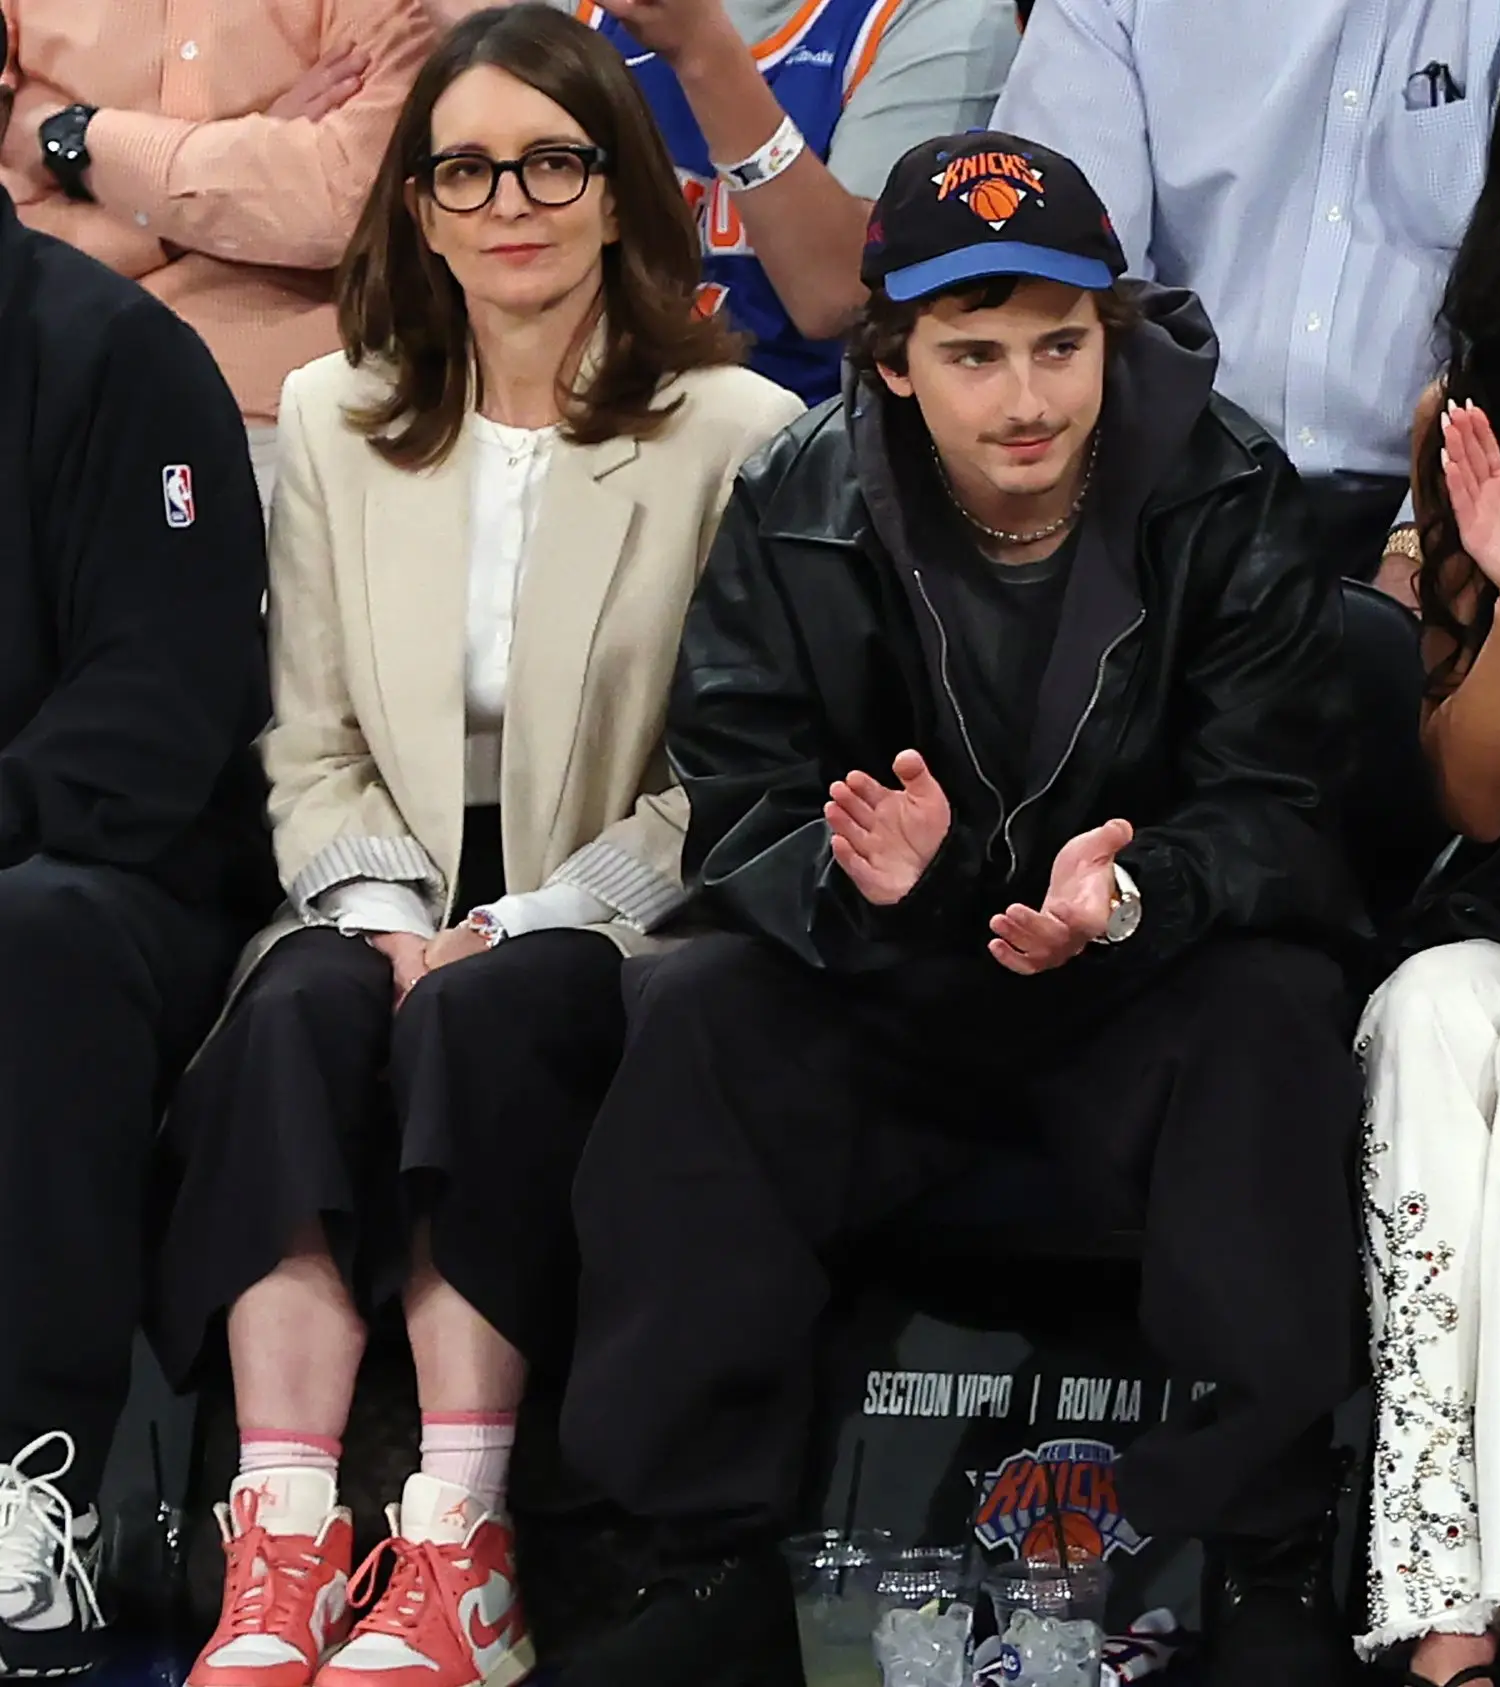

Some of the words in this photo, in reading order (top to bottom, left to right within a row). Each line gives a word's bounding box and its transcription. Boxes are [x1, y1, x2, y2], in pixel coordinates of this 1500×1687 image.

[937, 152, 1045, 201] KNICKS
[863, 1371, 952, 1417] SECTION
[1056, 1376, 1112, 1421] ROW
[1112, 1379, 1142, 1422] AA
[976, 1458, 1119, 1526] KNICK
